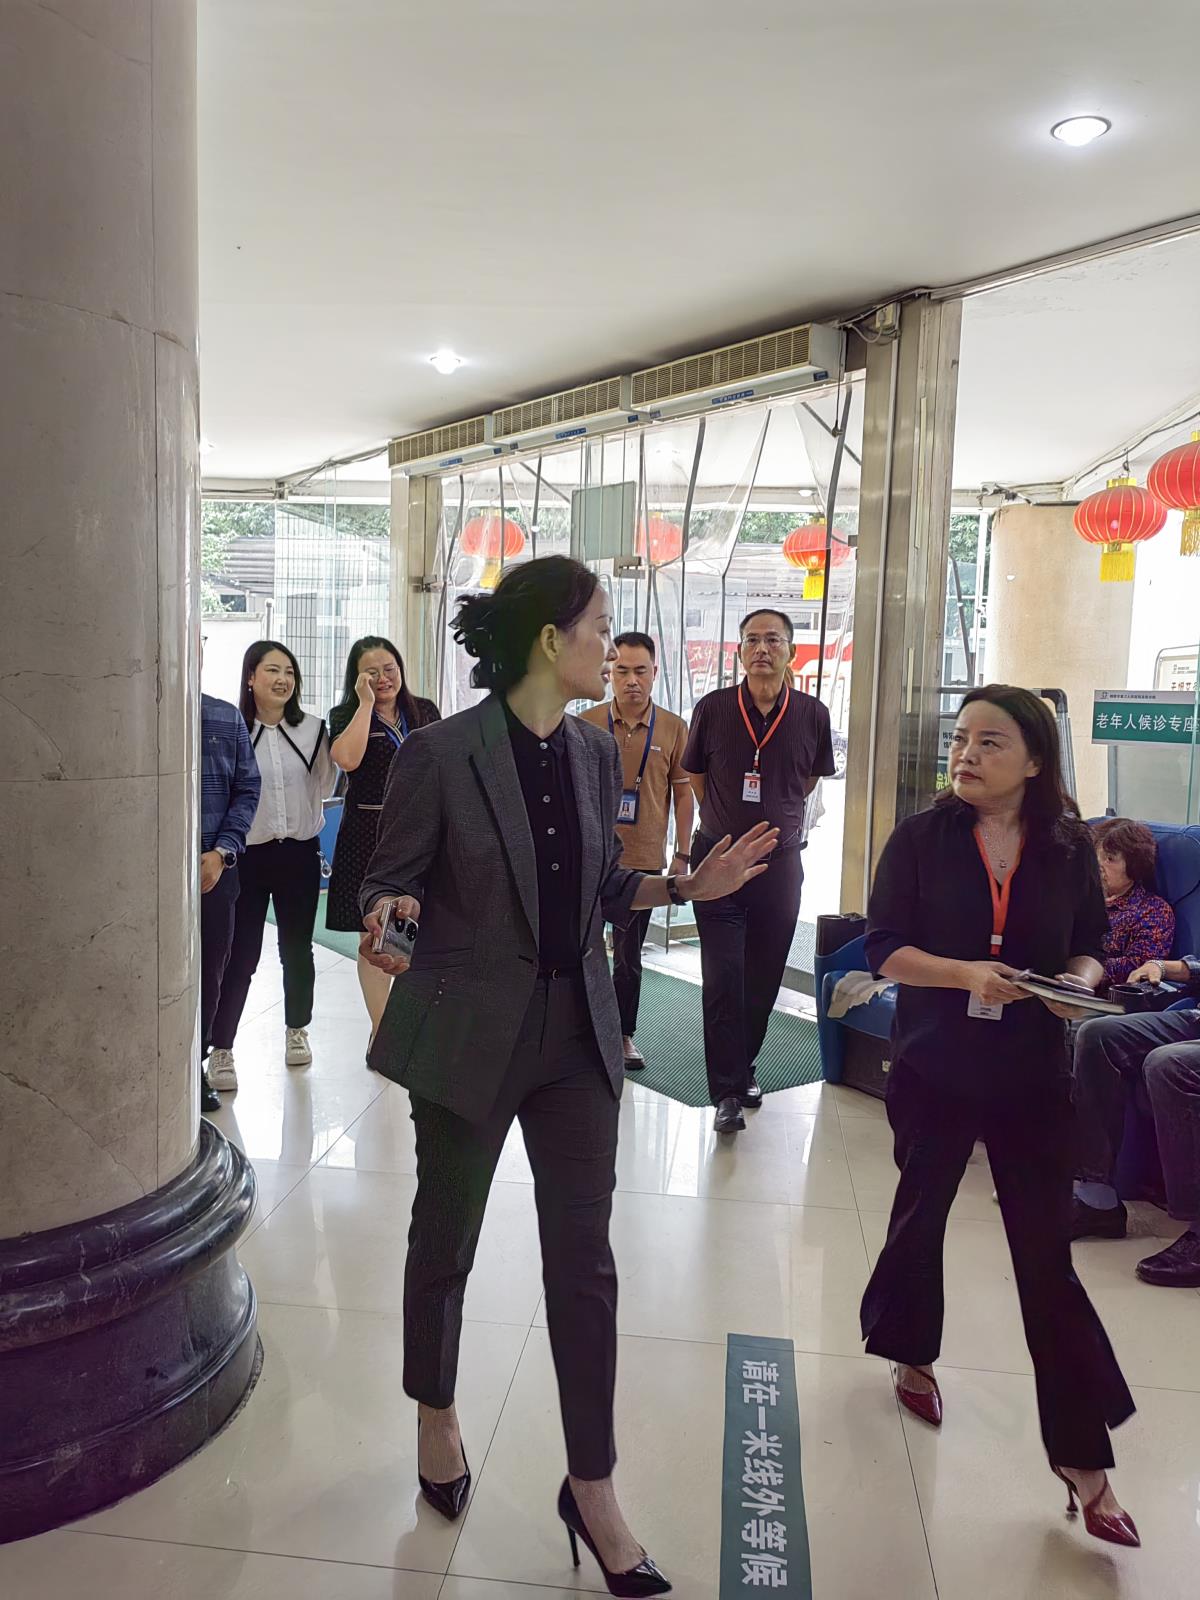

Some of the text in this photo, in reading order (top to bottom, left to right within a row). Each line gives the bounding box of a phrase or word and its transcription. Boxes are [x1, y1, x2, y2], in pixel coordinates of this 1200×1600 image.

[1096, 713, 1200, 732] 老年人候诊专座
[742, 1360, 788, 1588] 请在一米线外等候
